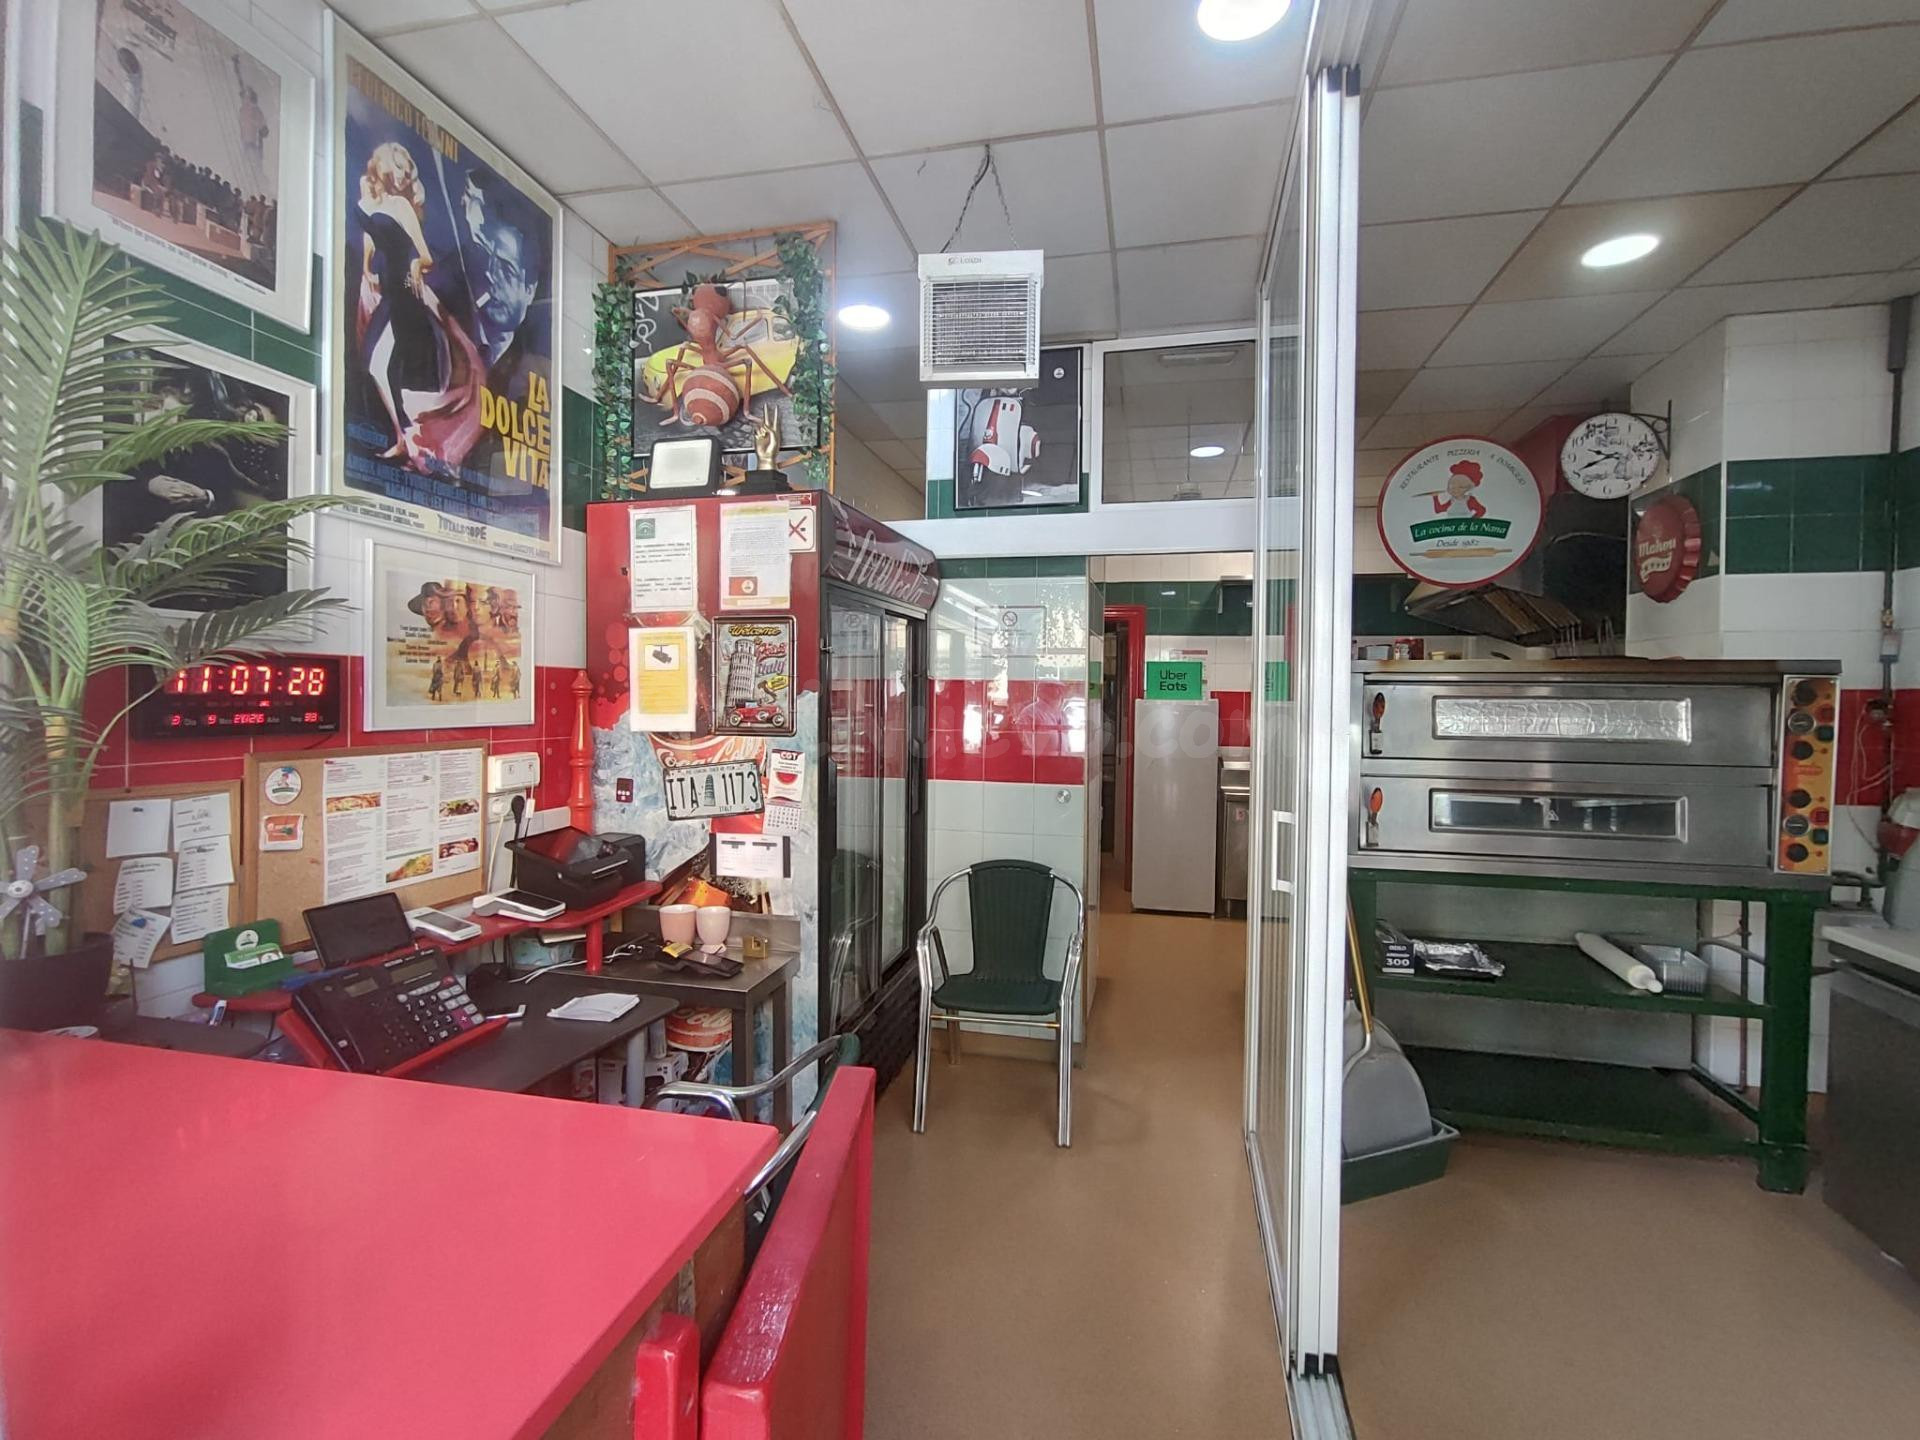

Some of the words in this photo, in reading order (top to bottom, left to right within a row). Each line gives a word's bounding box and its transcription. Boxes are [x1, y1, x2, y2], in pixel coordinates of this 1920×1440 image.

[527, 371, 549, 414] LA
[479, 384, 551, 453] DOLCE
[502, 436, 550, 490] VITA
[1400, 454, 1440, 490] RESTAURANTE
[1446, 448, 1481, 457] PIZZERIA
[1414, 528, 1426, 538] La
[1428, 523, 1455, 535] cocina
[1457, 522, 1468, 531] de
[1469, 522, 1479, 531] la
[1480, 522, 1507, 534] Nana
[1436, 539, 1460, 548] Desde
[1638, 536, 1677, 557] Mahou
[729, 624, 781, 637] Welcome
[1159, 669, 1188, 681] Uber
[1159, 681, 1188, 692] Eats
[780, 751, 798, 761] CGT
[666, 776, 700, 811] ITA
[721, 771, 759, 806] 1173
[1386, 957, 1410, 966] 300
